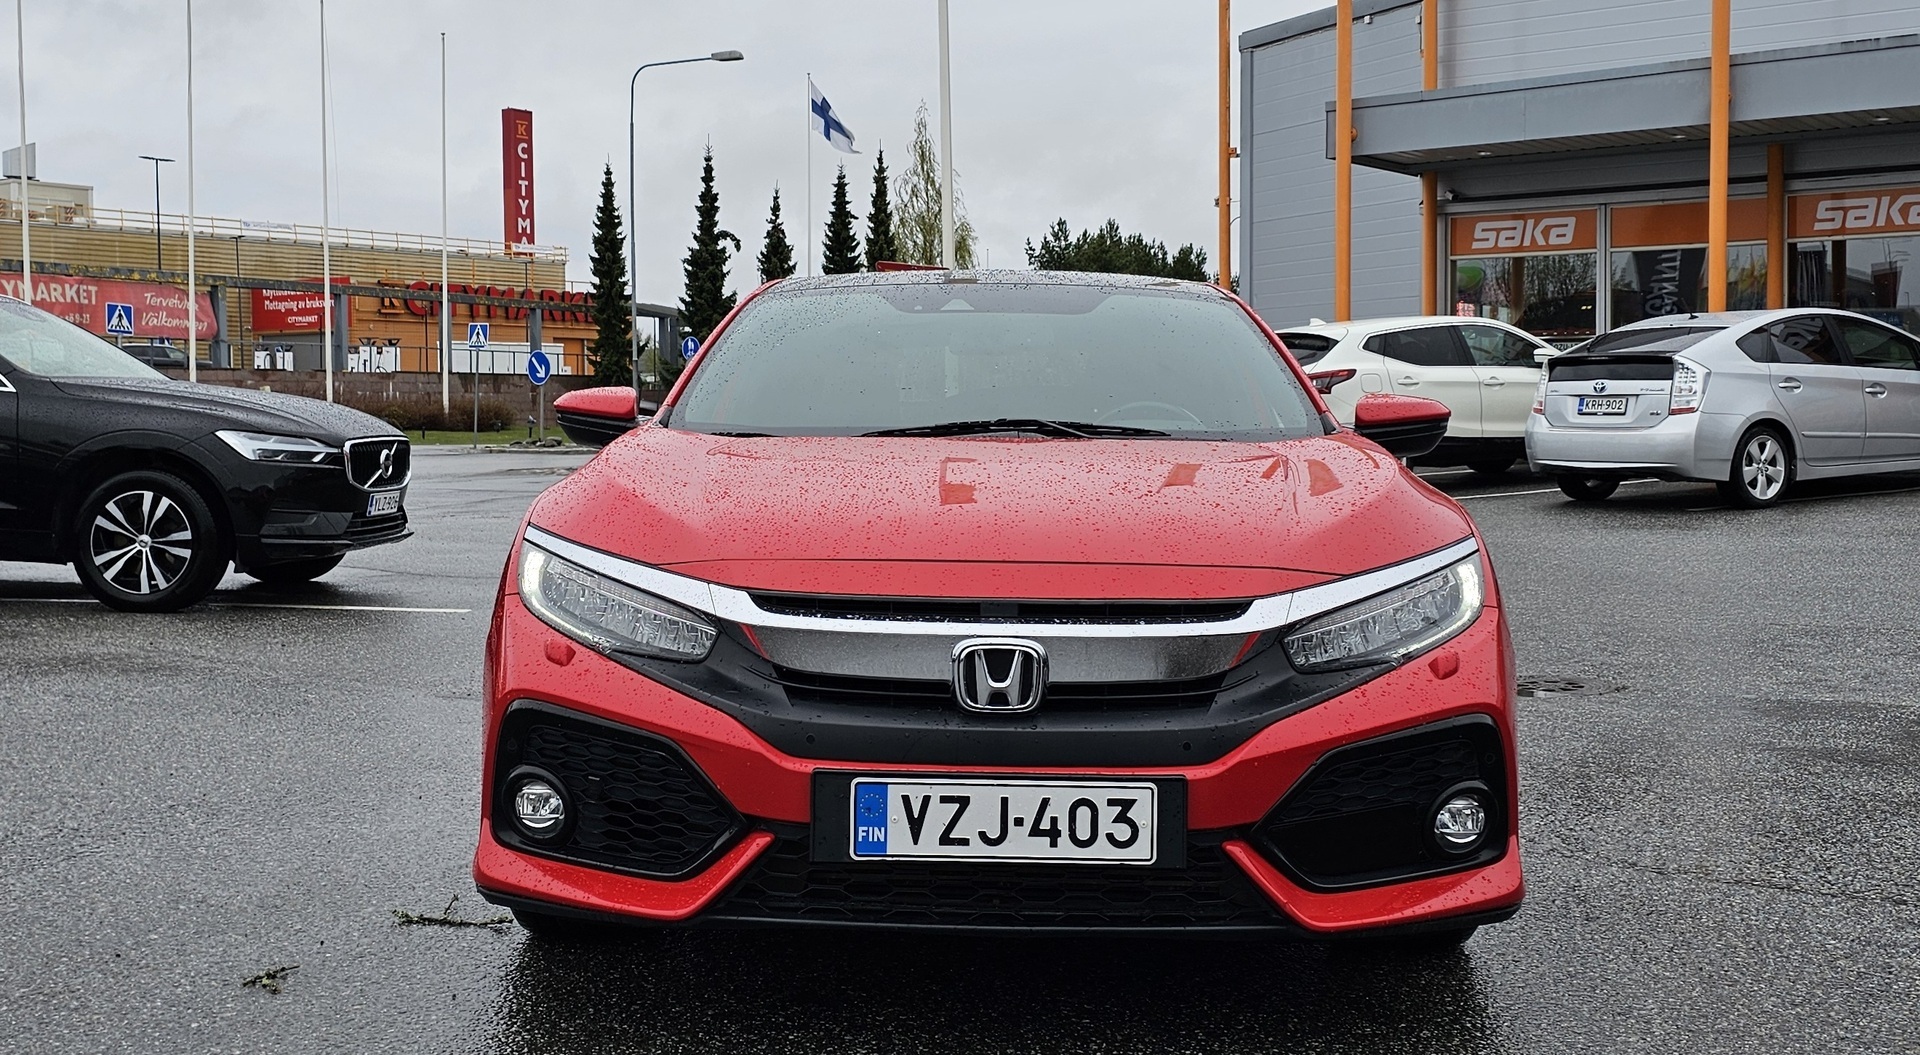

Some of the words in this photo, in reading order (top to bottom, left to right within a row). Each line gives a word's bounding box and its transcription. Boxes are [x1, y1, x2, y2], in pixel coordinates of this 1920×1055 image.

[407, 280, 594, 323] CITYMARK
[1585, 399, 1623, 411] KRH-902
[858, 826, 885, 842] FIN
[900, 794, 1140, 849] VZJ-403
